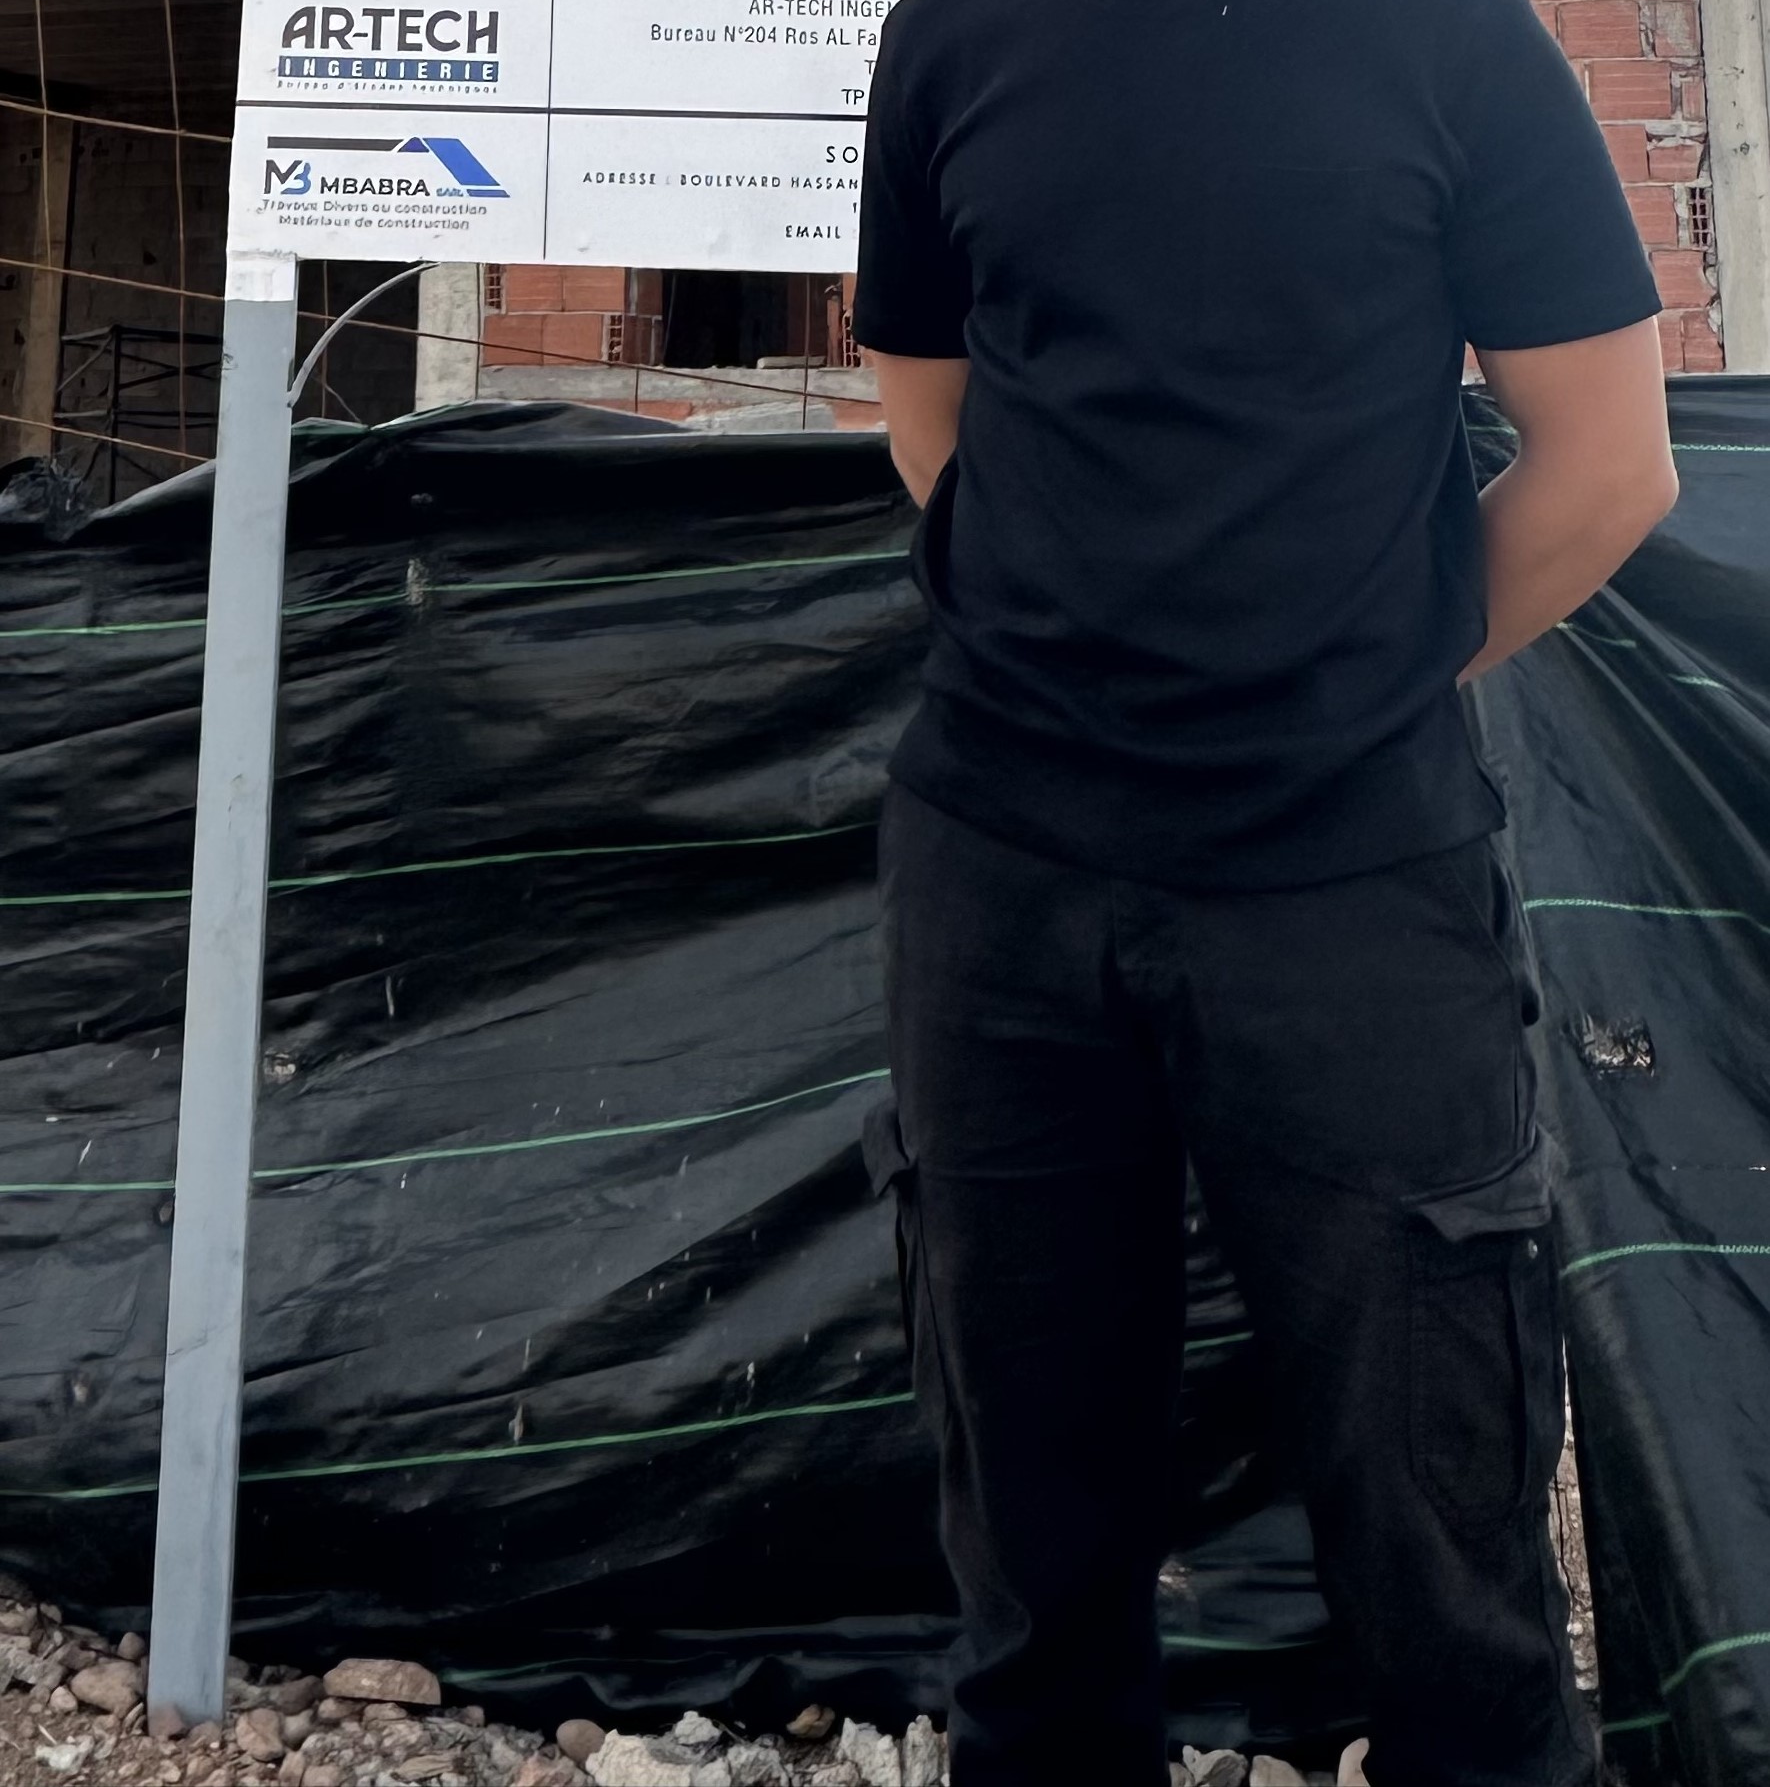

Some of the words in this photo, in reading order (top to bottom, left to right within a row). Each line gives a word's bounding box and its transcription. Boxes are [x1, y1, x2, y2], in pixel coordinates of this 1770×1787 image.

[282, 6, 499, 54] AR-TECH
[651, 24, 716, 41] Bureau
[724, 26, 777, 44] N°204
[826, 28, 851, 45] AL
[284, 58, 494, 81] INGENIERIE
[841, 89, 865, 105] TP
[320, 177, 430, 196] MBABRA
[583, 172, 657, 185] ADRESSE
[680, 174, 781, 188] BOULEVARD
[377, 218, 469, 230] construction
[785, 225, 841, 239] EMAIL
